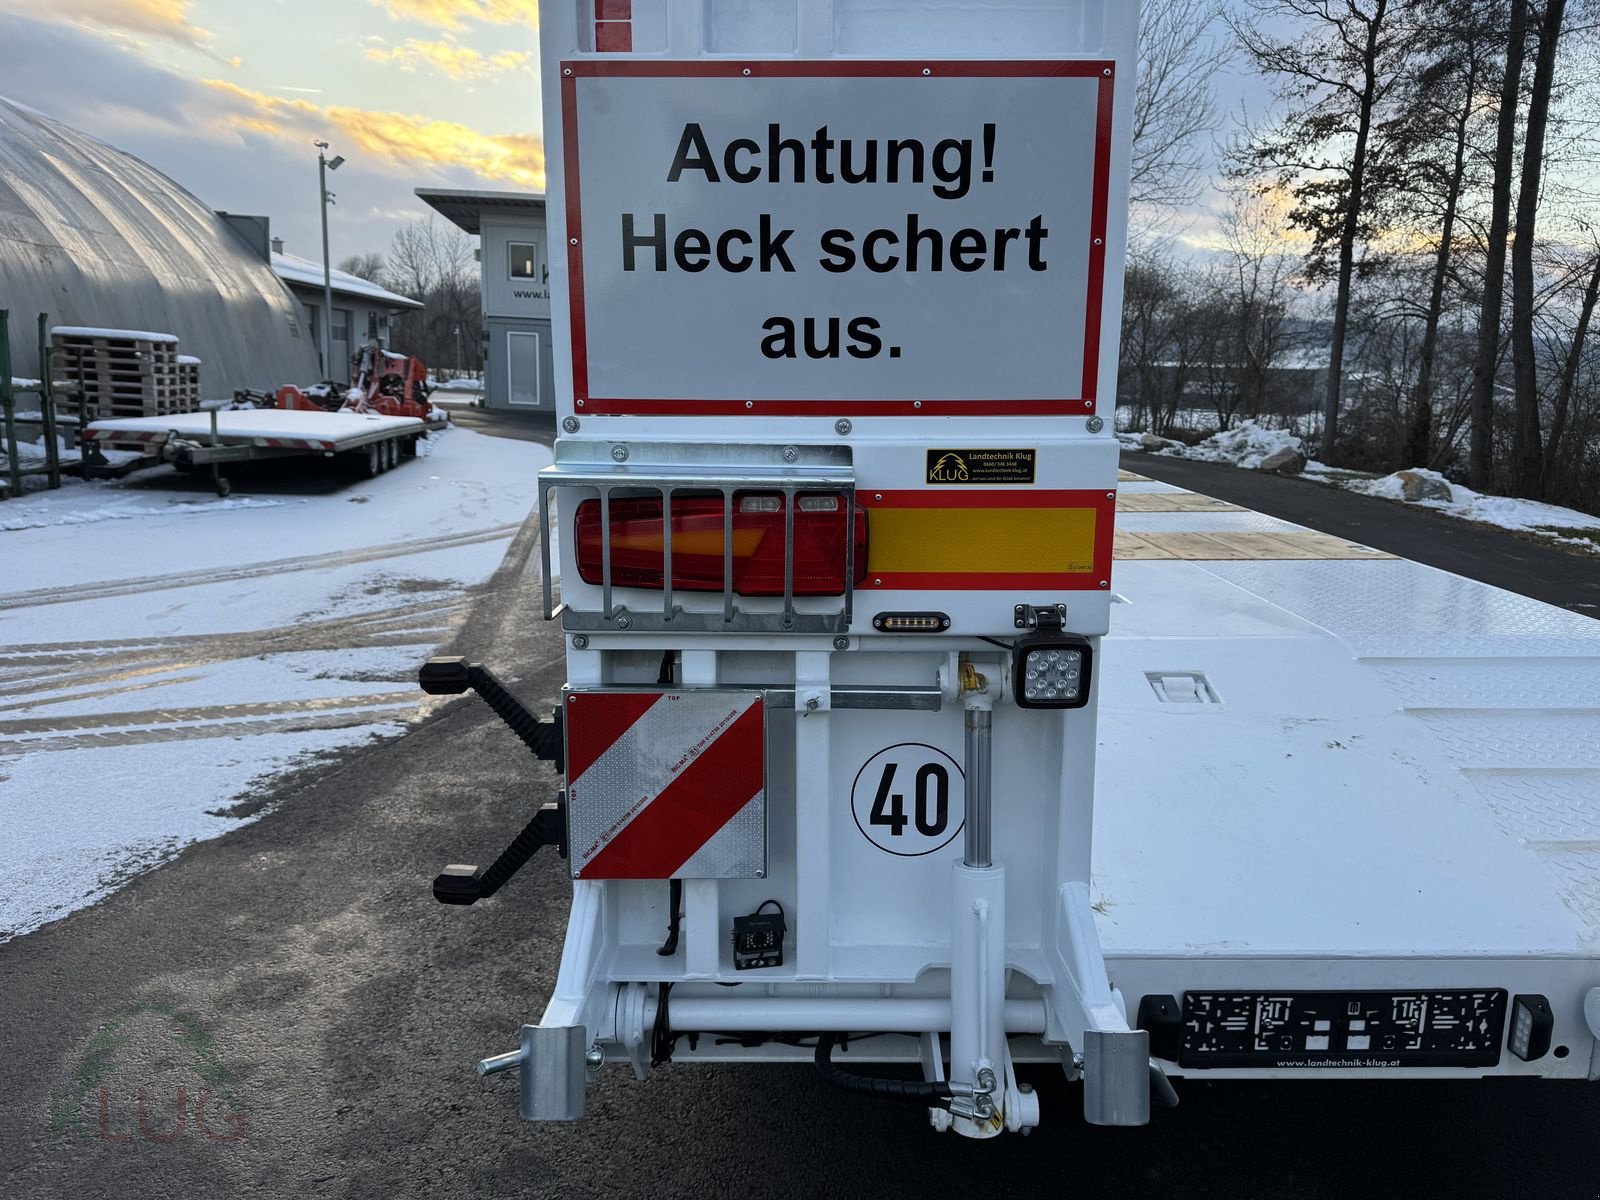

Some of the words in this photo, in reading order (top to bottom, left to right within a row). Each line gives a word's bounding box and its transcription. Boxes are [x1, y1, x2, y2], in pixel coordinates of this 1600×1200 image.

[666, 122, 997, 200] Achtung!
[621, 213, 796, 273] Heck
[818, 213, 1049, 273] schert
[760, 315, 902, 359] aus.
[929, 469, 969, 481] KLUG
[969, 452, 1014, 460] Landtechnik
[1015, 452, 1032, 461] Klug
[869, 763, 949, 837] 40
[1276, 1059, 1400, 1068] www.landtechnik-klug.at
